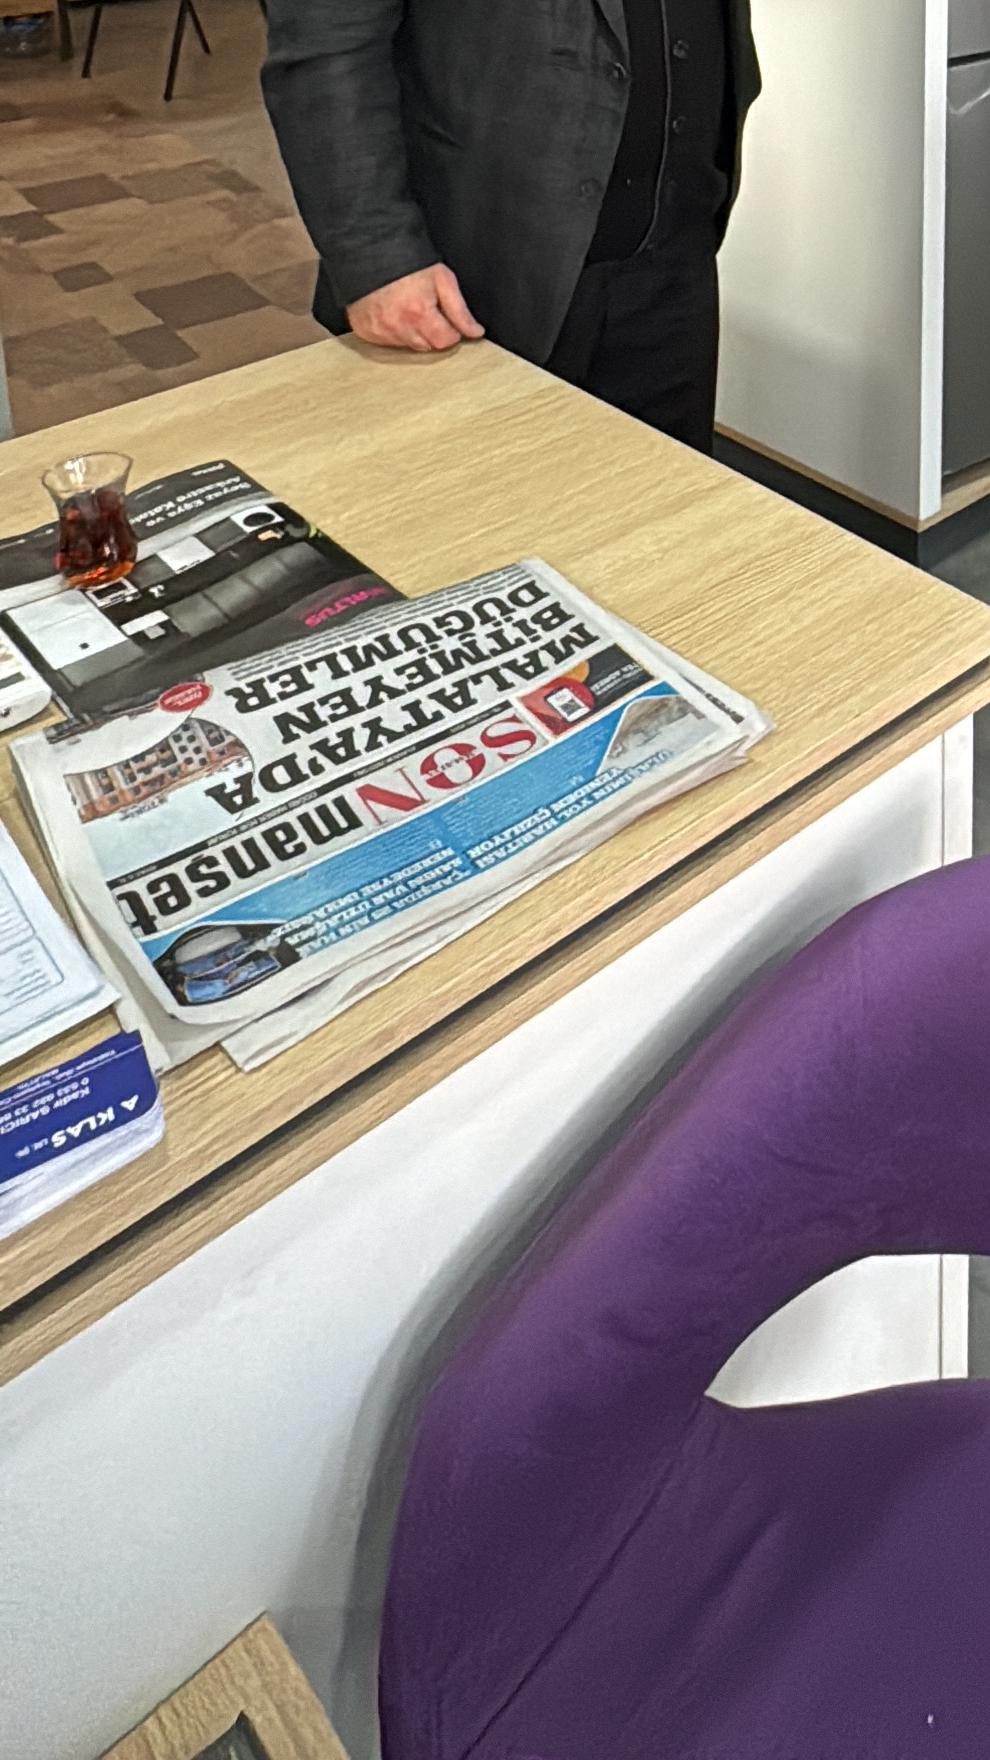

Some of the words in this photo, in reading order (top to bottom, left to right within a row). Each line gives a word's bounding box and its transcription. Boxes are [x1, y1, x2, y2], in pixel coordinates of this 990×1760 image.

[224, 580, 550, 714] DÜĞÜMLER
[272, 601, 576, 744] BİTMEYEN
[550, 768, 624, 811] YENİDEN
[557, 797, 594, 820] YOL
[467, 806, 552, 858] ÇİZİLİYOR
[476, 817, 559, 868] HARİTASI
[117, 794, 364, 935] manşet
[53, 1086, 90, 1109] Kadir
[120, 1094, 139, 1111] A
[51, 1106, 115, 1148] KLAS
